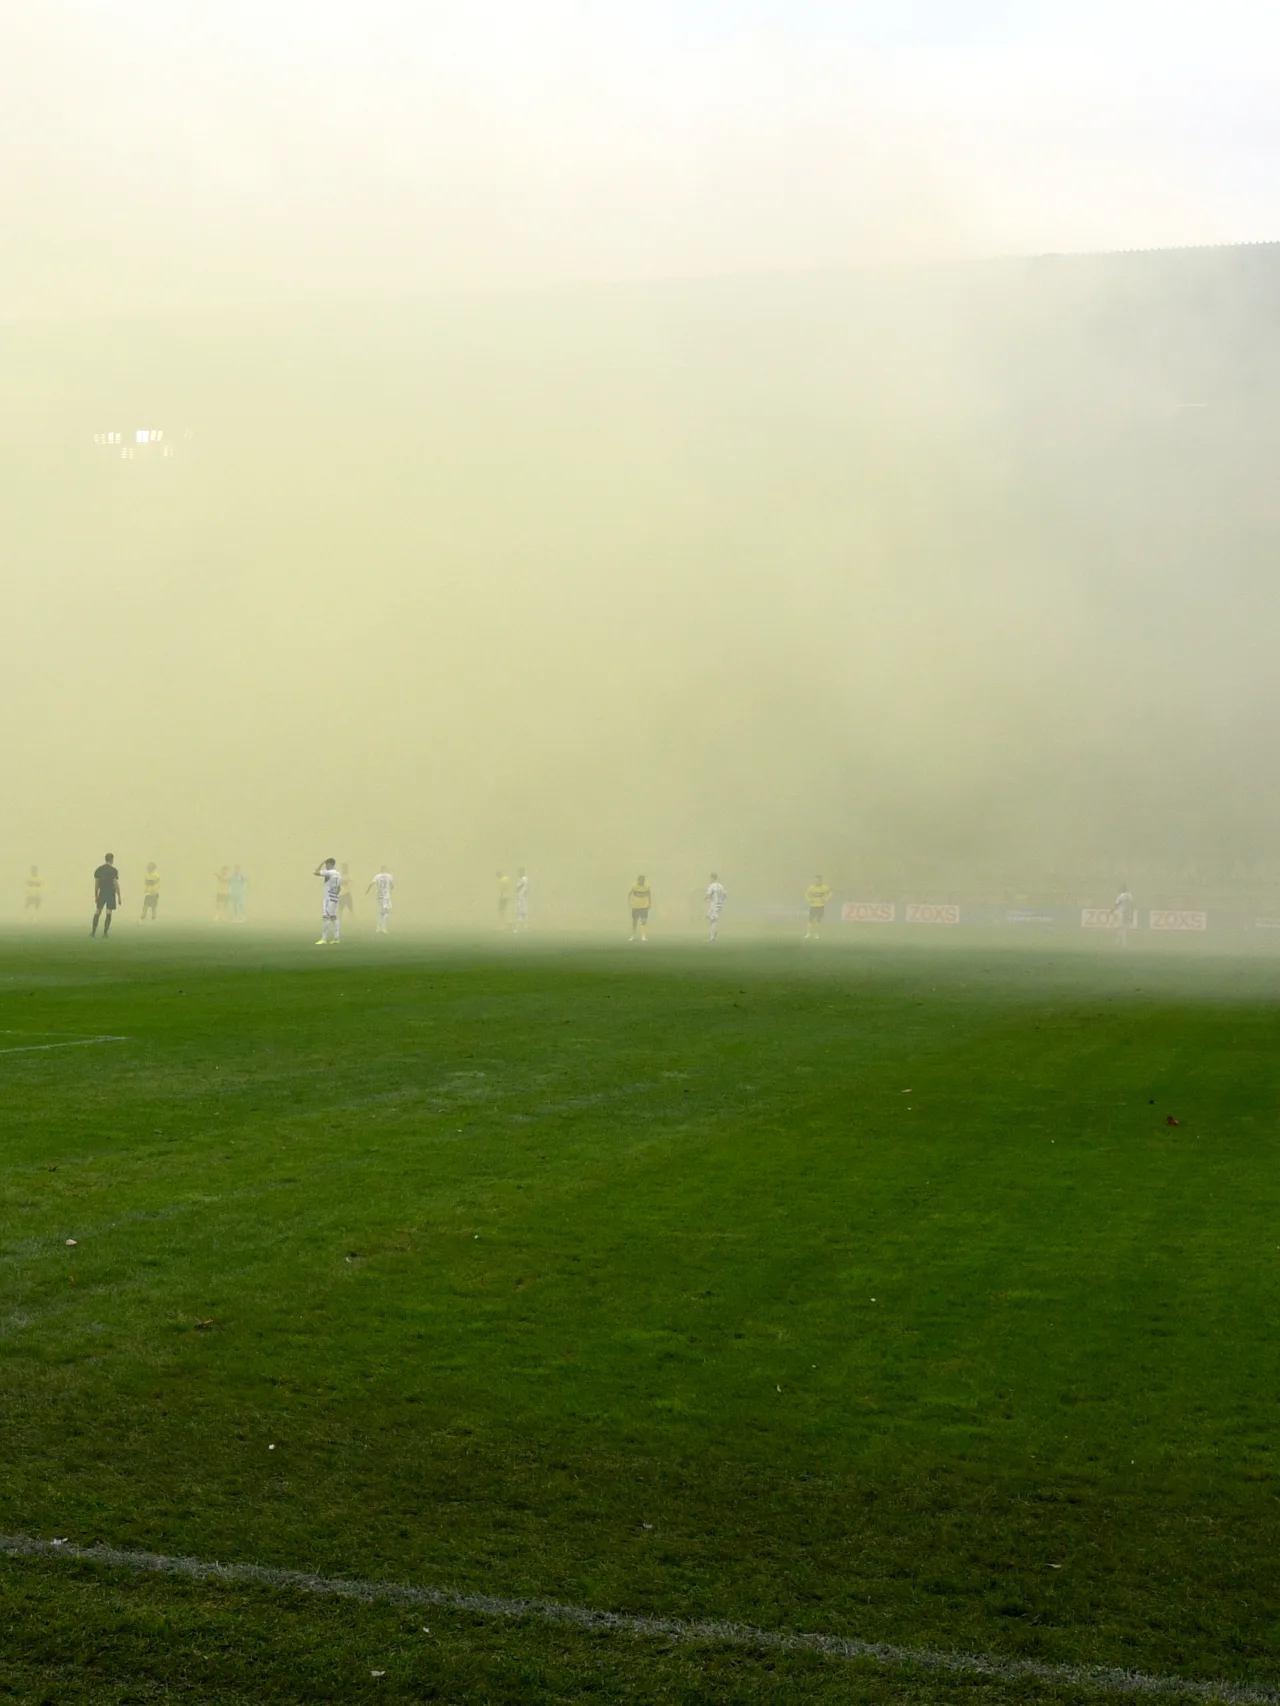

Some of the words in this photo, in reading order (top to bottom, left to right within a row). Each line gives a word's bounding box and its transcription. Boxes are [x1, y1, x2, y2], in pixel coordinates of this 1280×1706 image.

[845, 903, 892, 920] ZOXS
[908, 905, 956, 922] ZOXS
[1152, 912, 1203, 929] ZOXS
